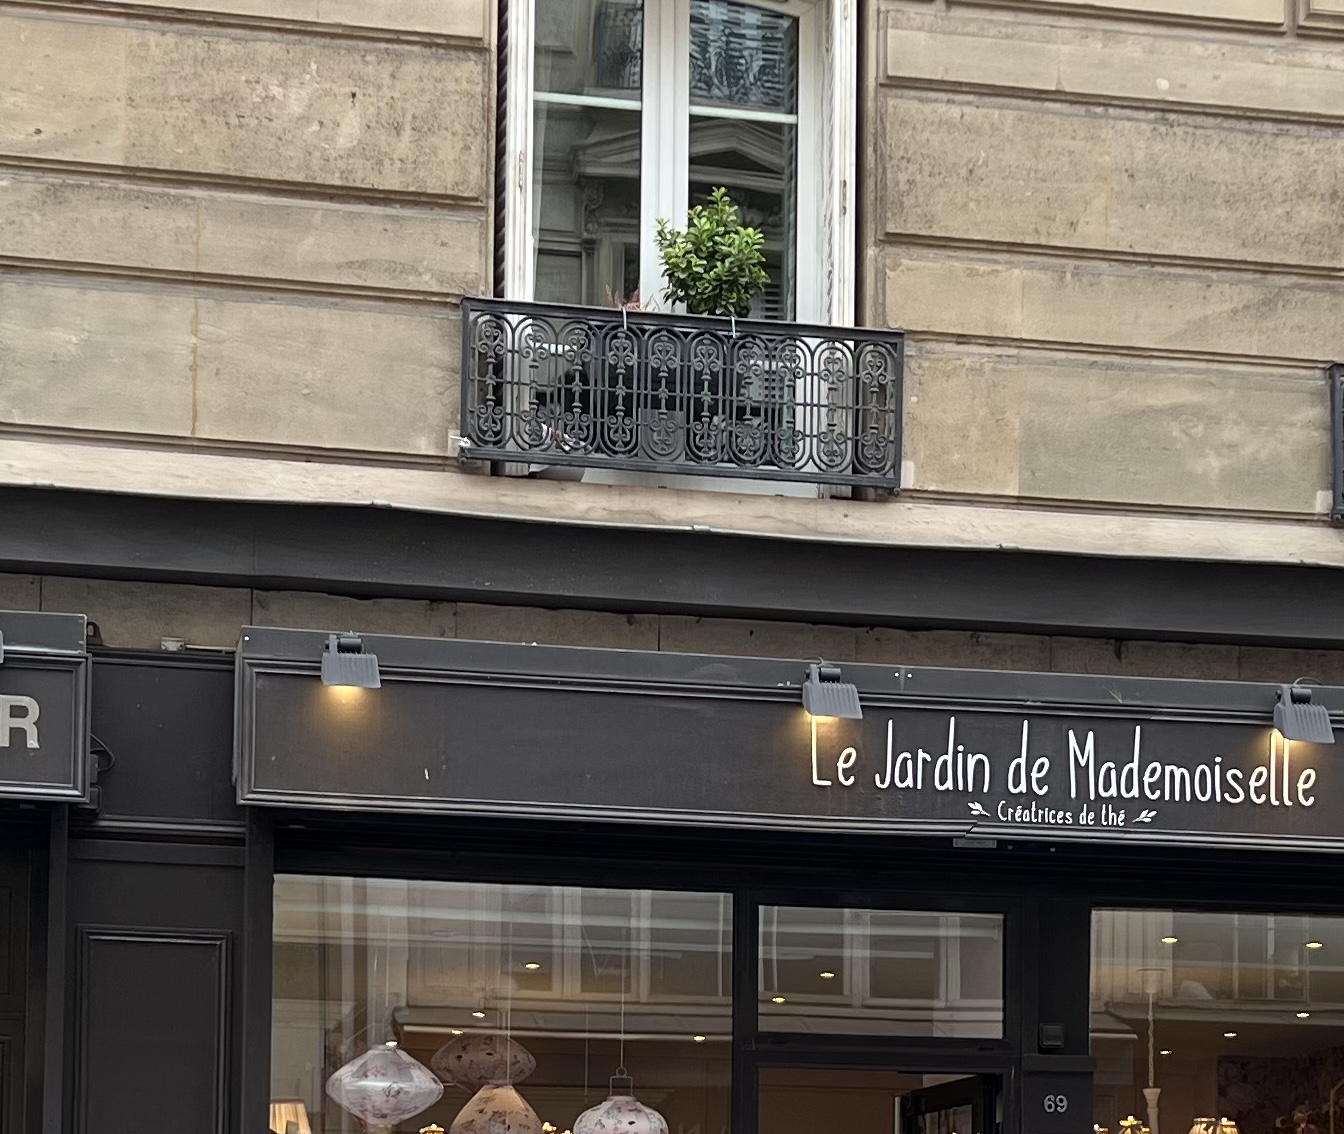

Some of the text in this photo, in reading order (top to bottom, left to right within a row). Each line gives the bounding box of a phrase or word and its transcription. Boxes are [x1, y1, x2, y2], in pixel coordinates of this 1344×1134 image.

[811, 715, 1317, 807] Le Jardin de Mademoiselle
[997, 802, 1126, 828] Créatrices de thé
[1043, 1094, 1068, 1114] 69
